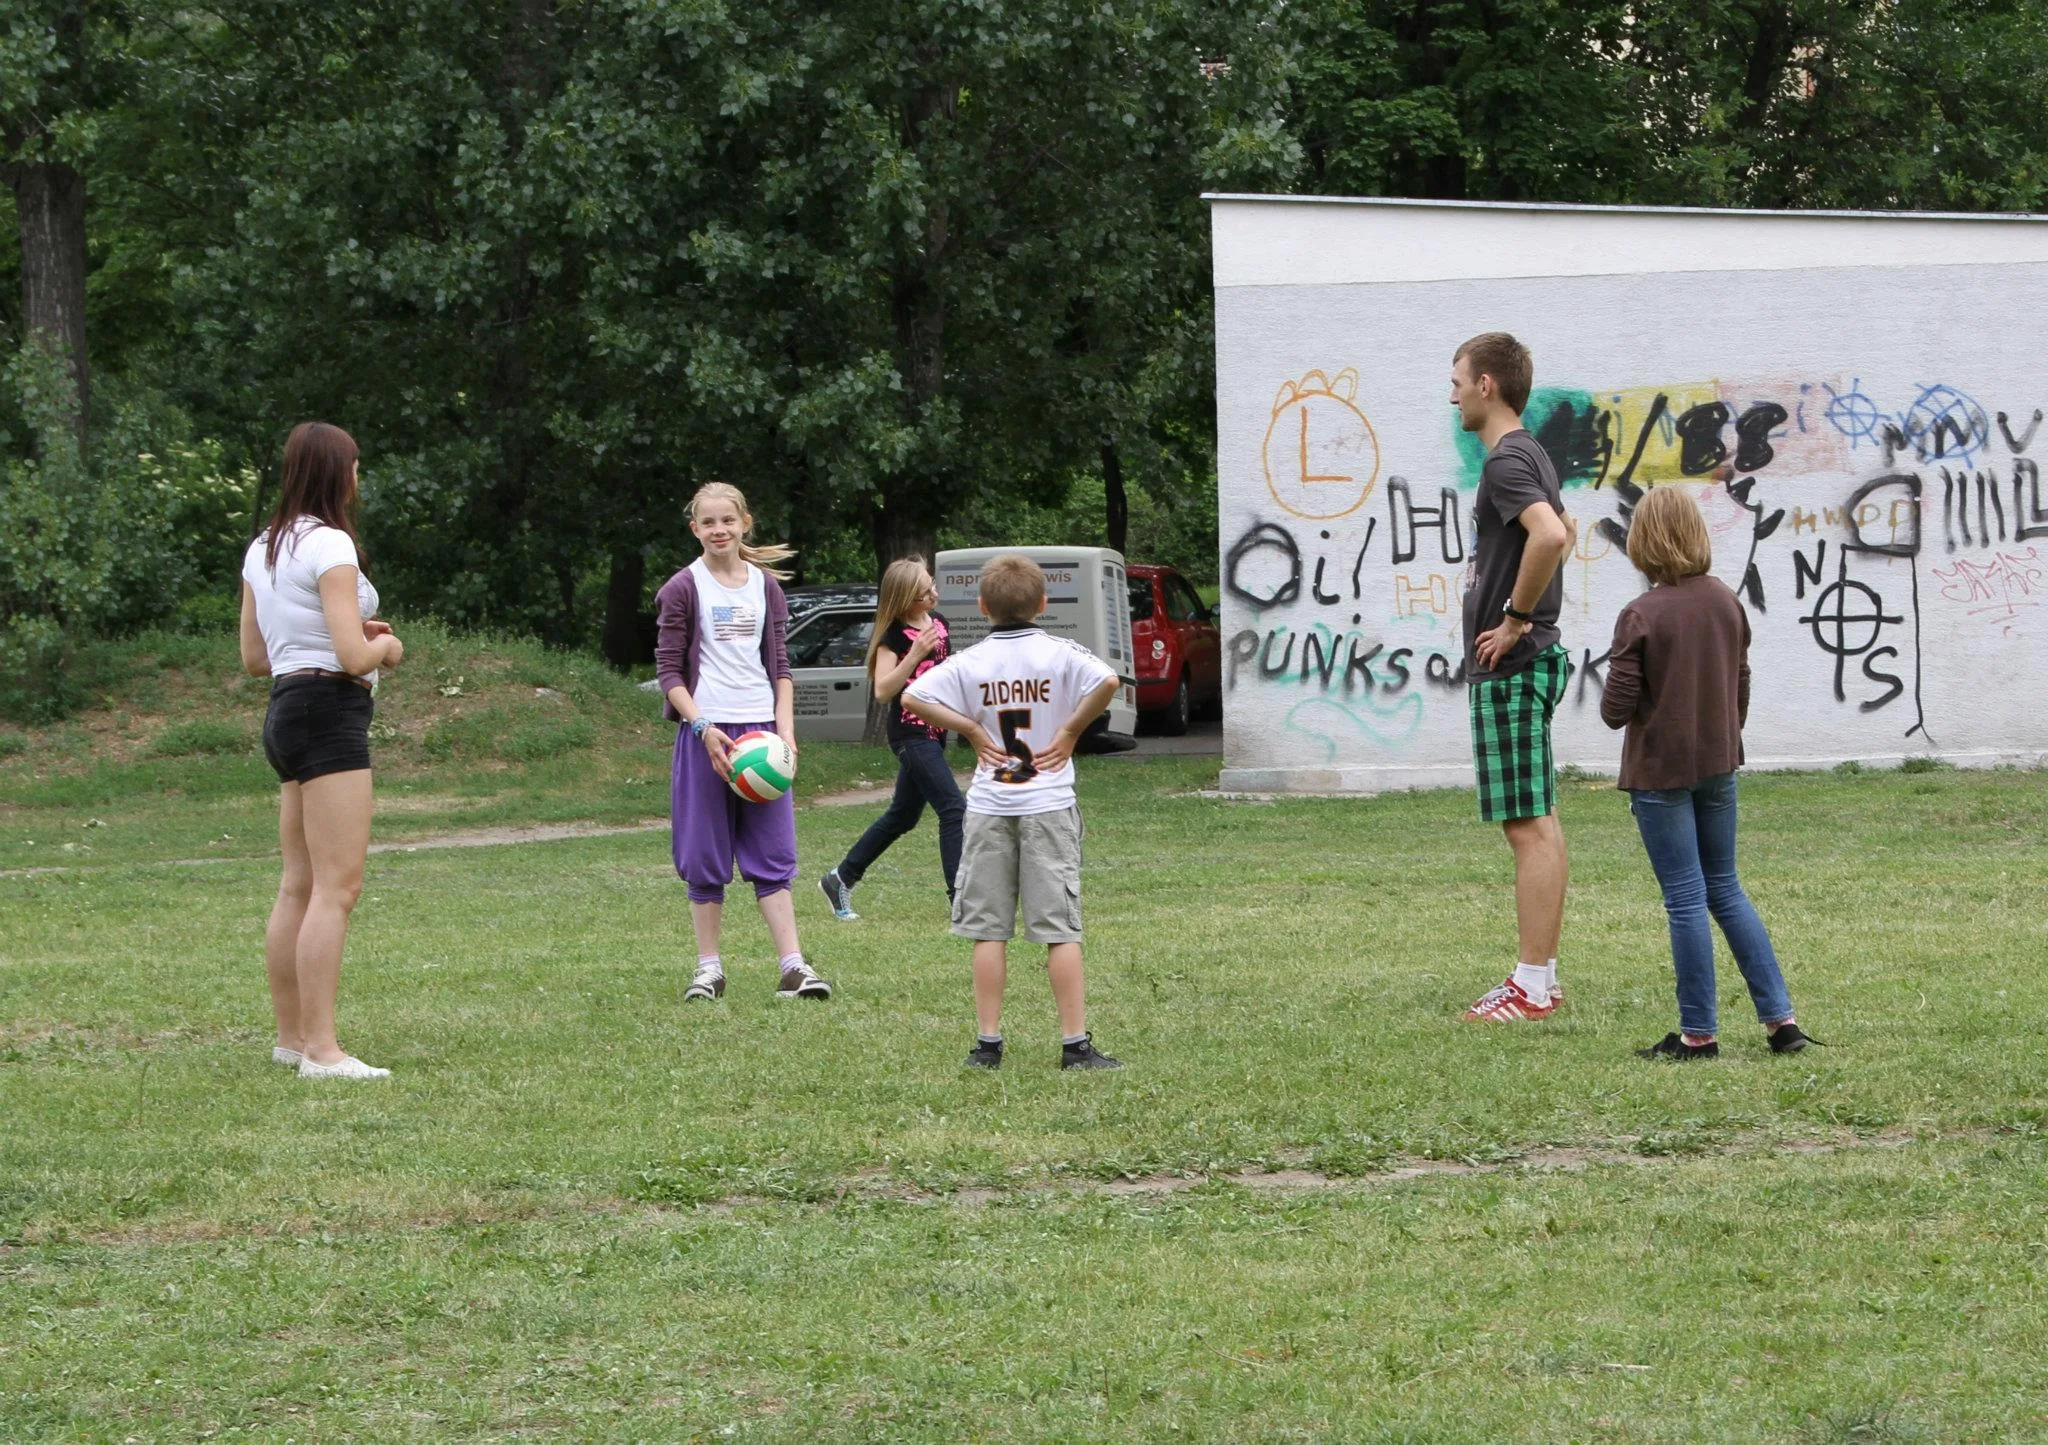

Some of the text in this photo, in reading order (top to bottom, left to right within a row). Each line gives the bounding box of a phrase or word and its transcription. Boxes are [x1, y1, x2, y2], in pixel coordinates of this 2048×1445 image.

[1045, 570, 1072, 584] wis
[979, 679, 1051, 706] ZIDANE
[991, 708, 1039, 784] 5
